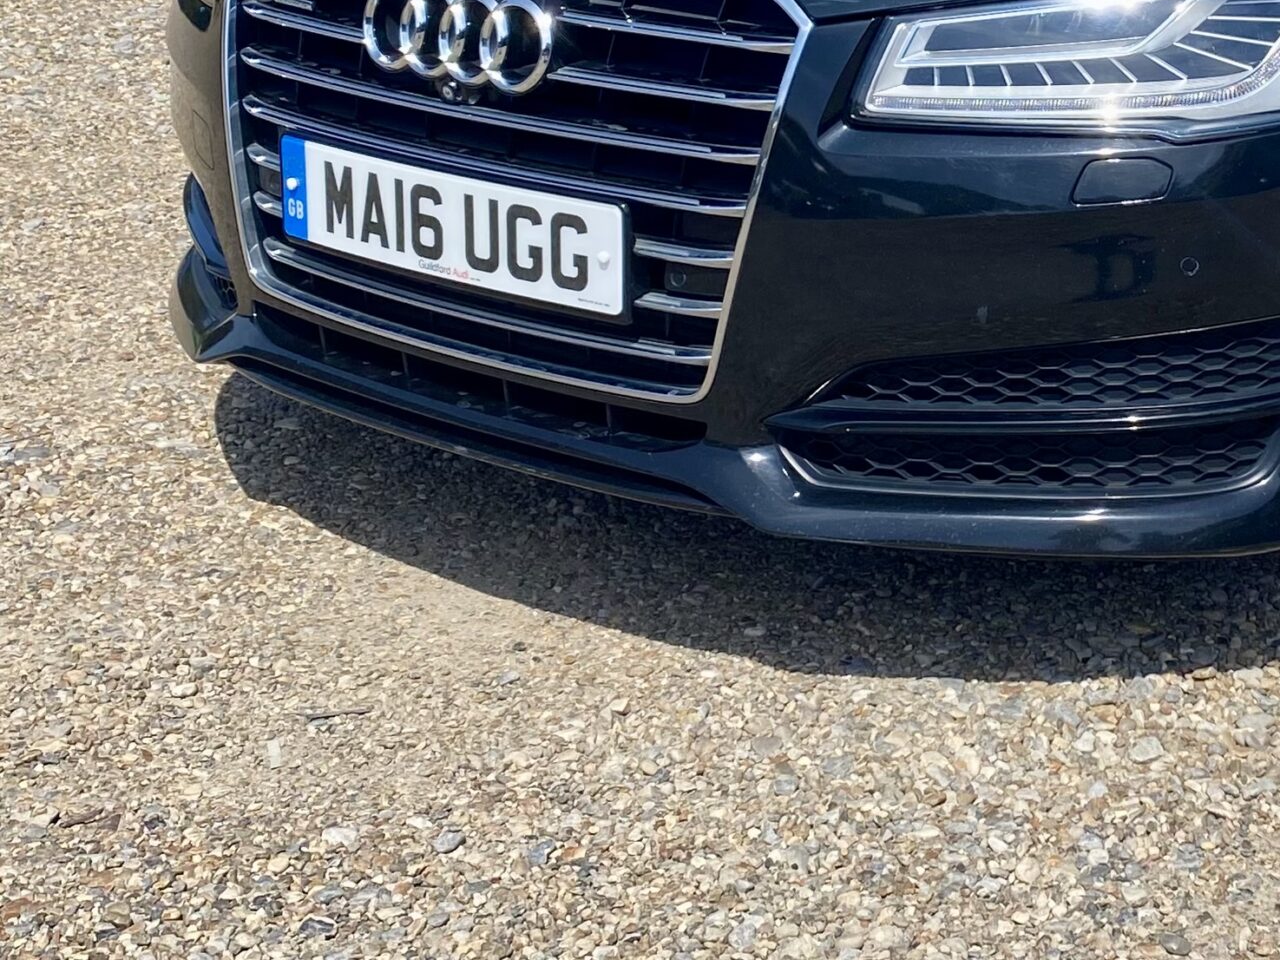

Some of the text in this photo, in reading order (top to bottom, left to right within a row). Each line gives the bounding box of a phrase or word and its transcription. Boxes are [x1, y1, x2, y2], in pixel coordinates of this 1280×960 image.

[288, 198, 304, 220] GB
[323, 160, 589, 292] MA16 UGG
[418, 258, 469, 280] Guildford Audi
